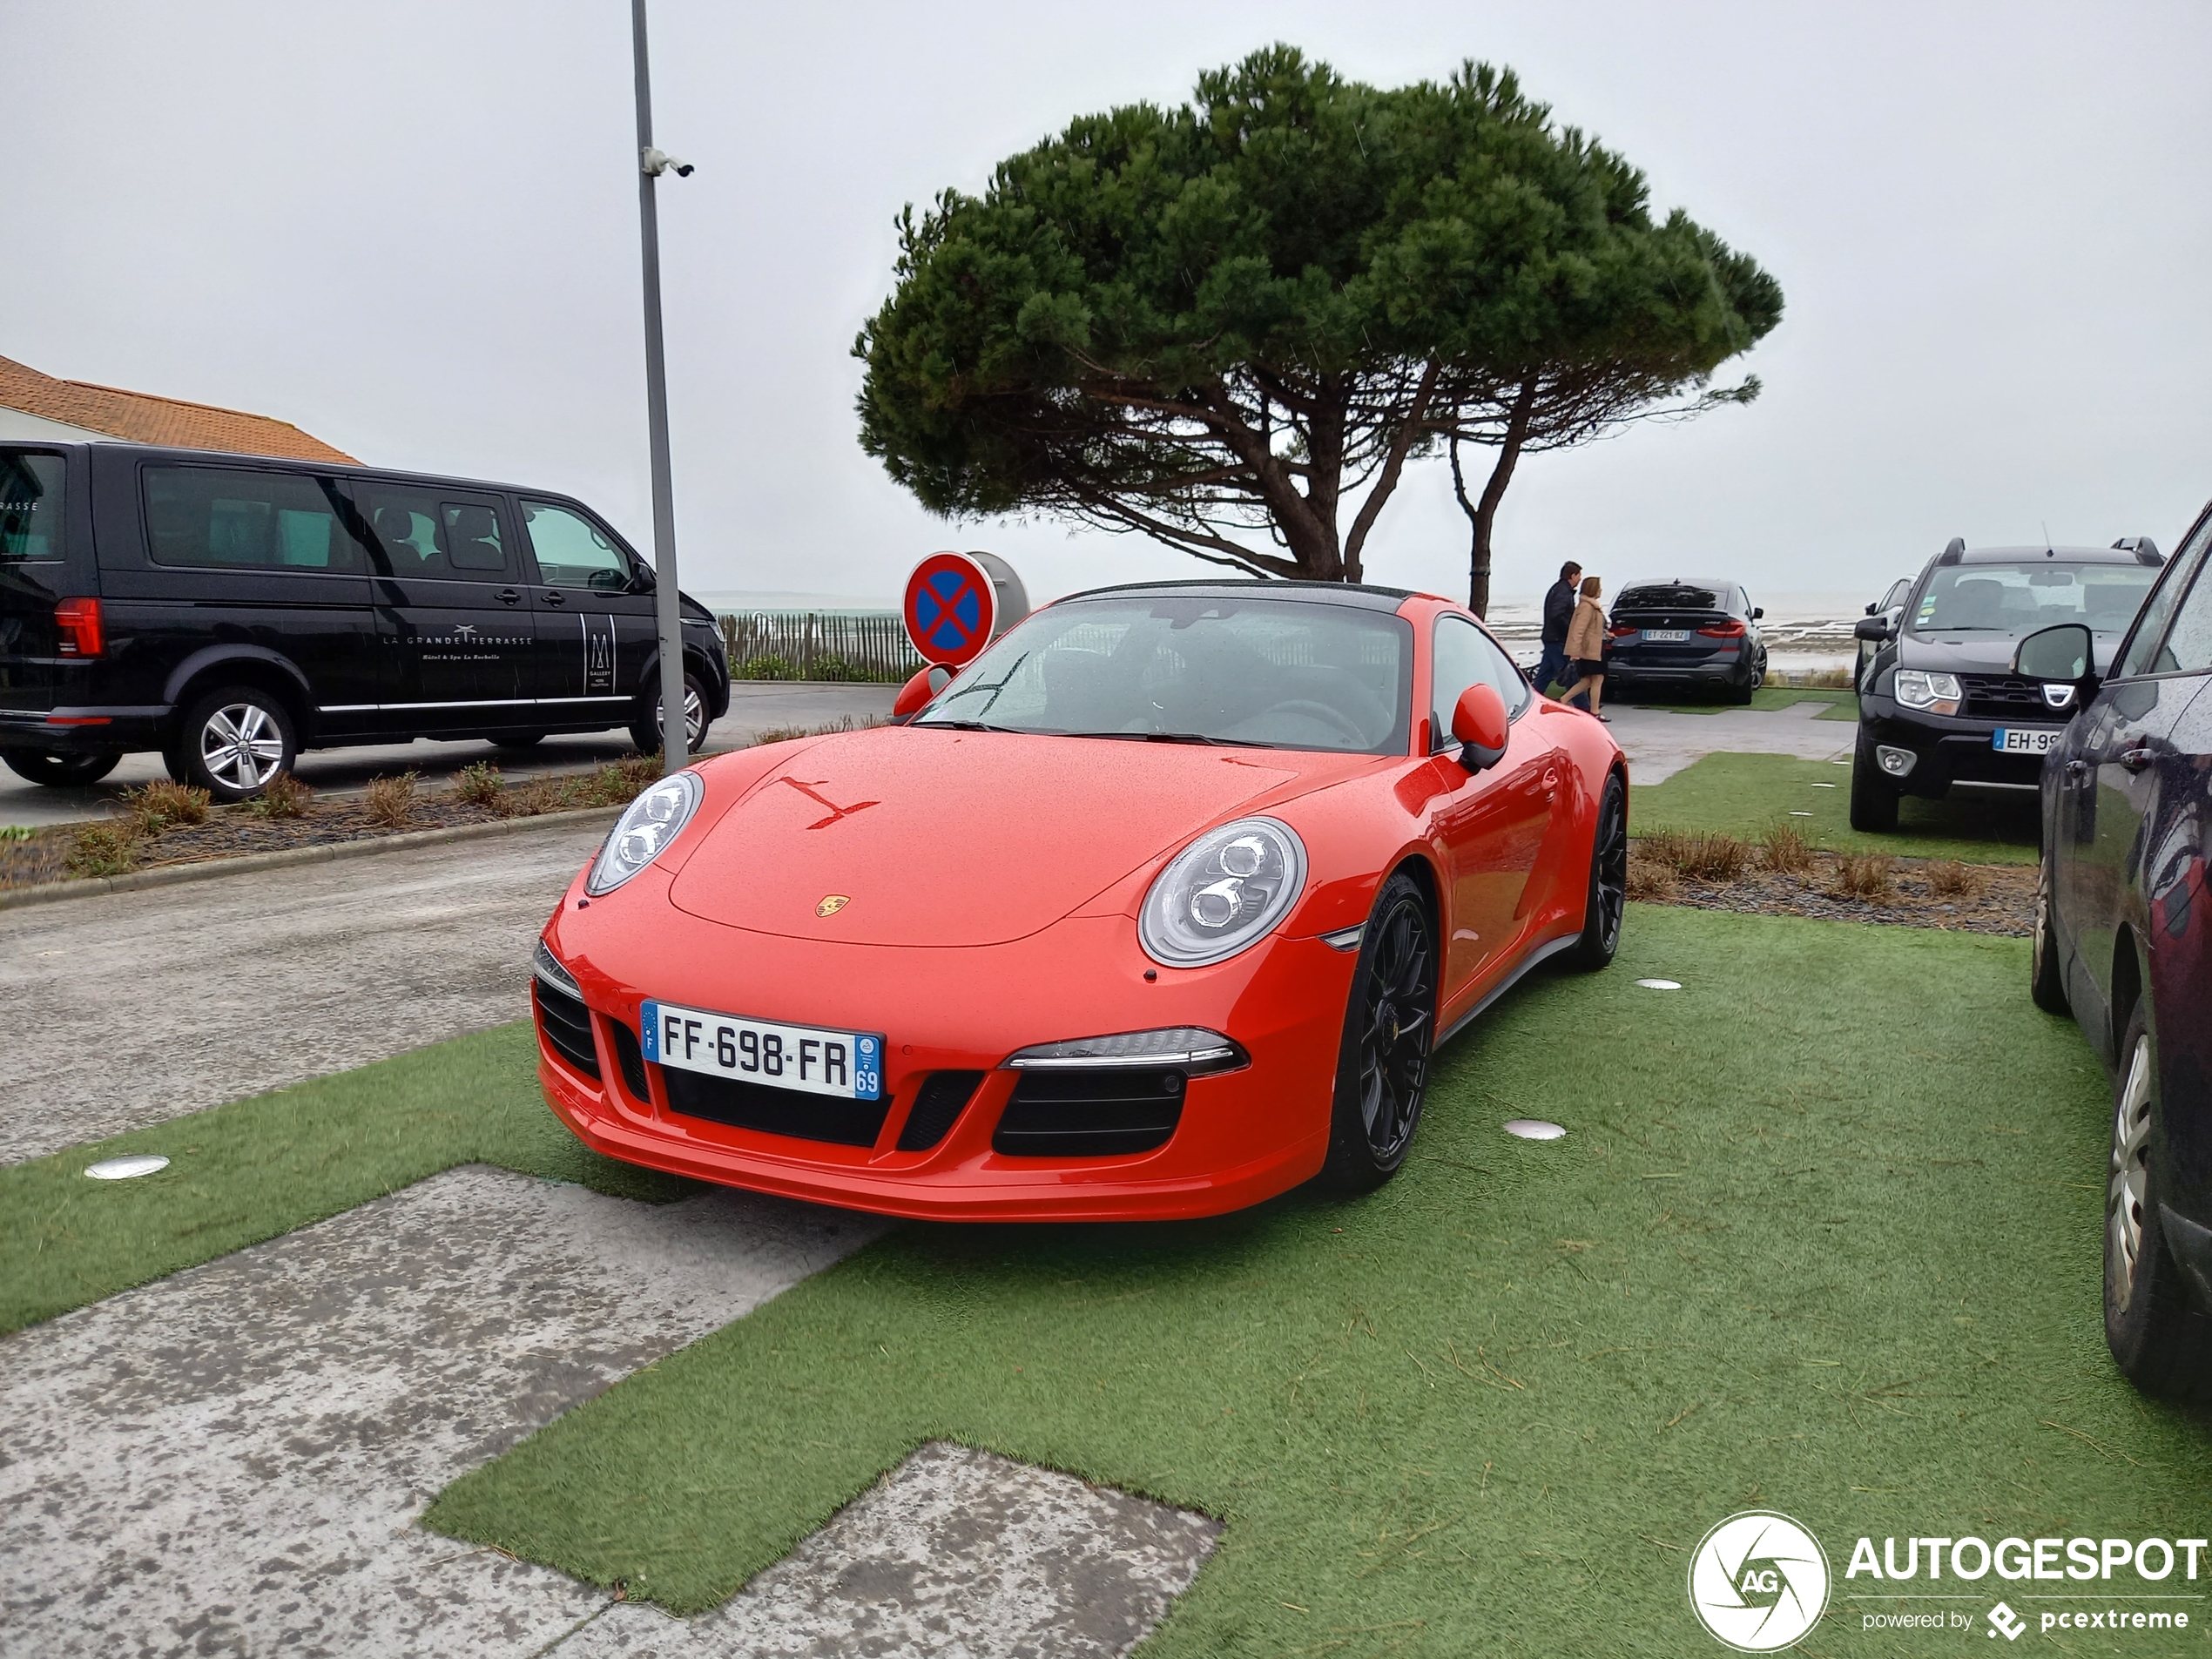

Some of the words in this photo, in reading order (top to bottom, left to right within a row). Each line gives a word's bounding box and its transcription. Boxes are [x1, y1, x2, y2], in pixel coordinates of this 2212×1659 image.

[471, 637, 532, 645] TERRASSE
[646, 1037, 653, 1049] F
[664, 1015, 846, 1086] FF-698-FR
[857, 1070, 878, 1093] 69
